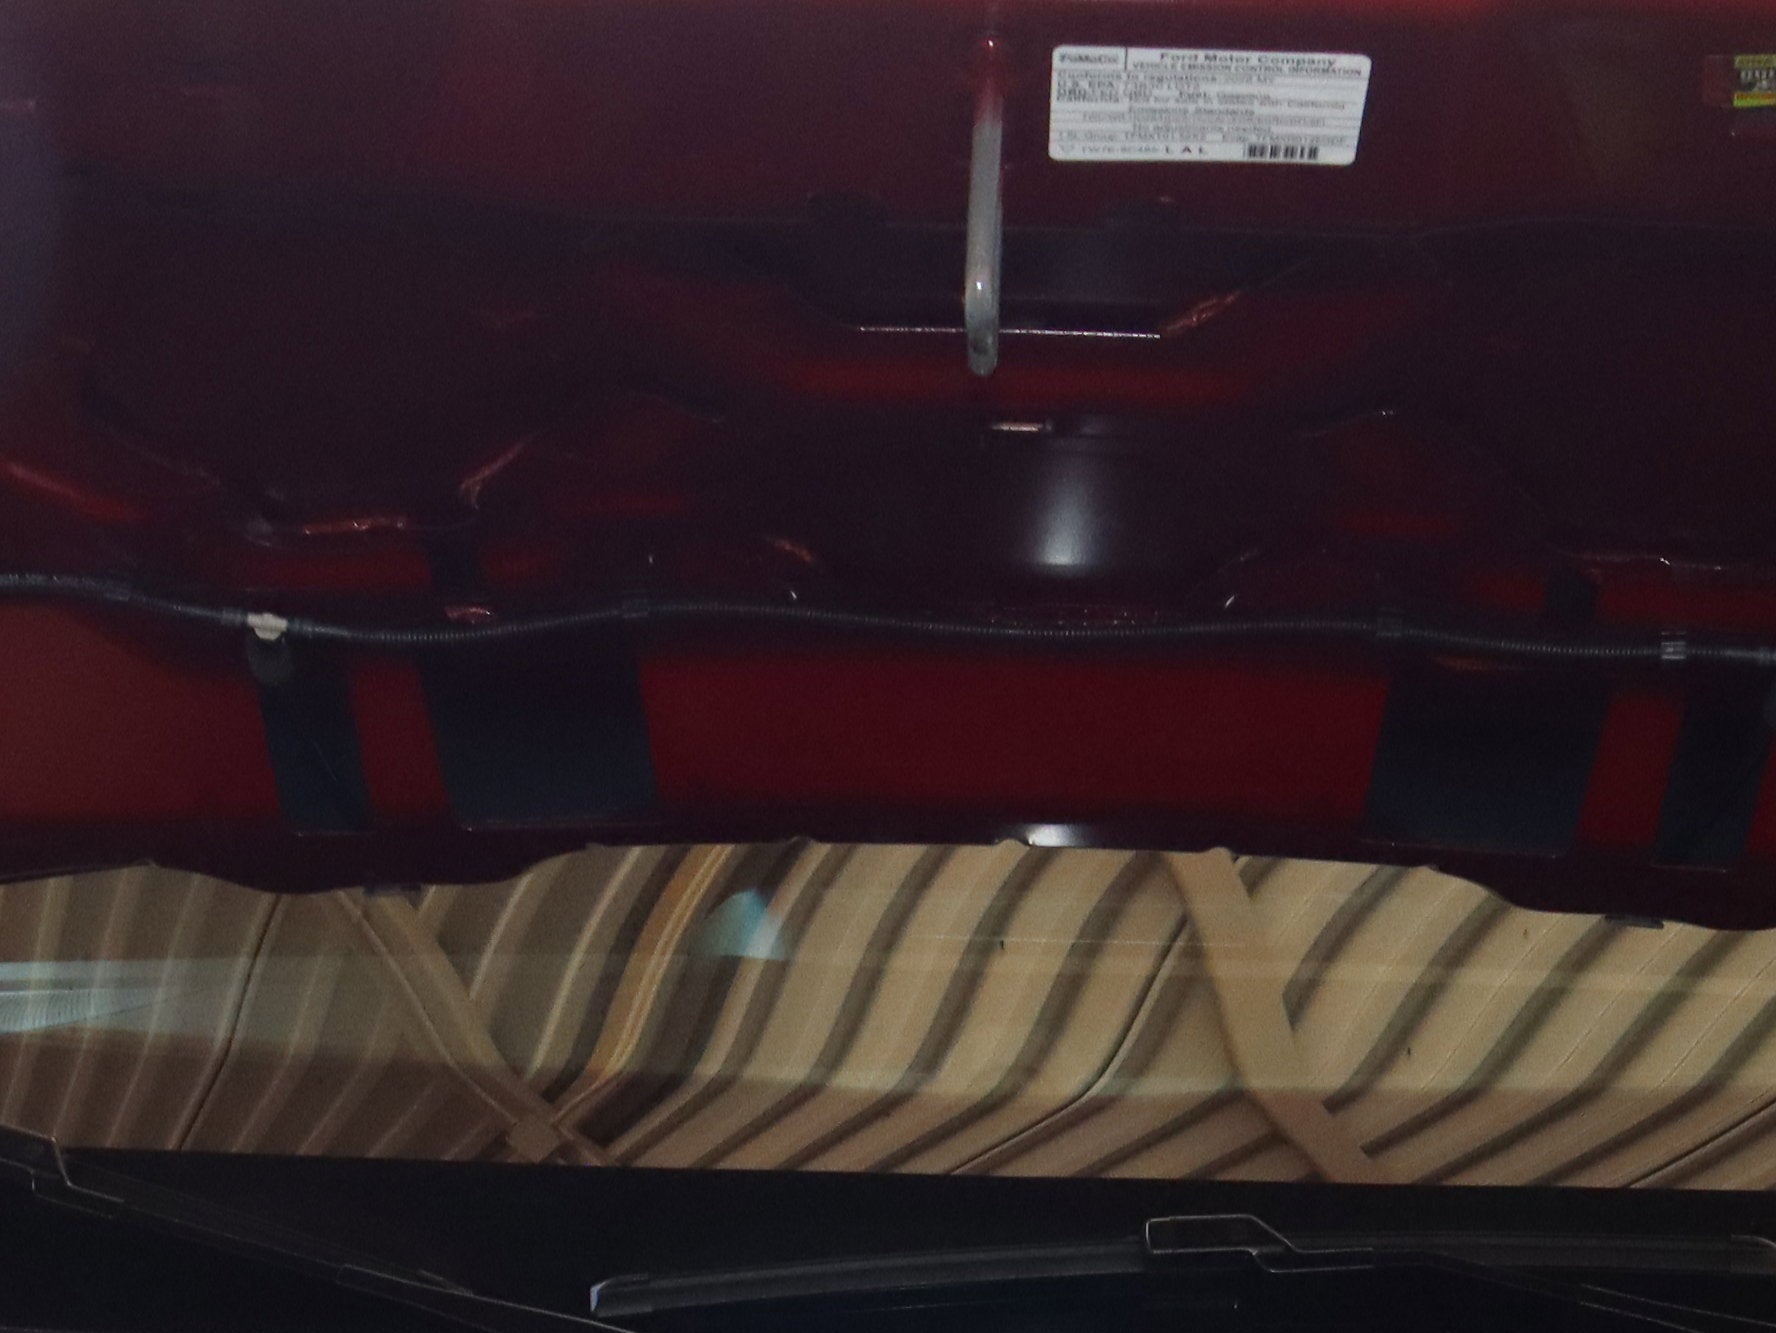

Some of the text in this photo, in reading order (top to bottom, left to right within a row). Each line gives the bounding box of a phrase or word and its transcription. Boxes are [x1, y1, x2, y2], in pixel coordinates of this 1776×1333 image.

[1159, 52, 1337, 68] Ford Motor Company
[1288, 65, 1362, 77] INFORMATION
